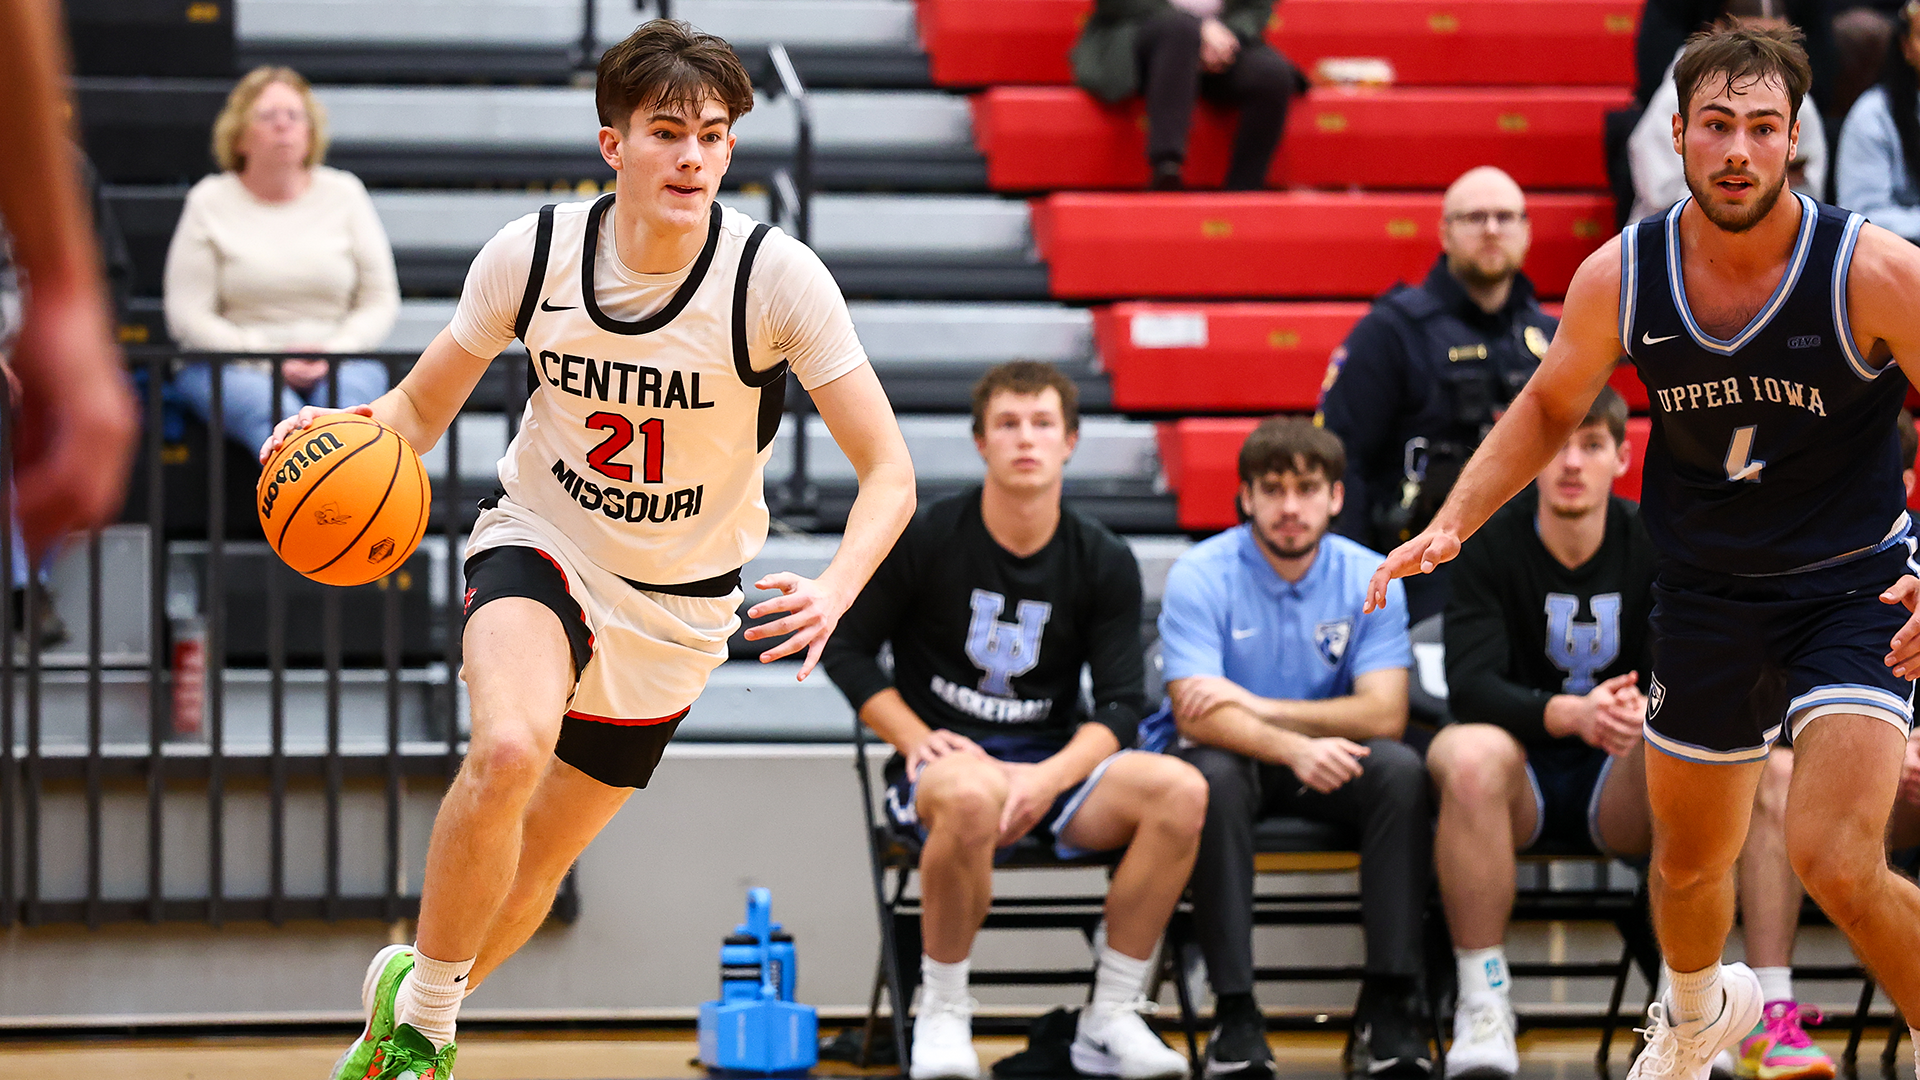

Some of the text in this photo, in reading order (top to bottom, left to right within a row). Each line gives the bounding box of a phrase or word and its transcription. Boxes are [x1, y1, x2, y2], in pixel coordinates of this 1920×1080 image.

[539, 350, 715, 409] CENTRAL
[1657, 376, 1827, 417] UPPER IOWA
[262, 432, 346, 520] Wilson
[585, 411, 664, 484] 21
[1723, 424, 1766, 483] 4
[551, 458, 704, 523] MISSOURI
